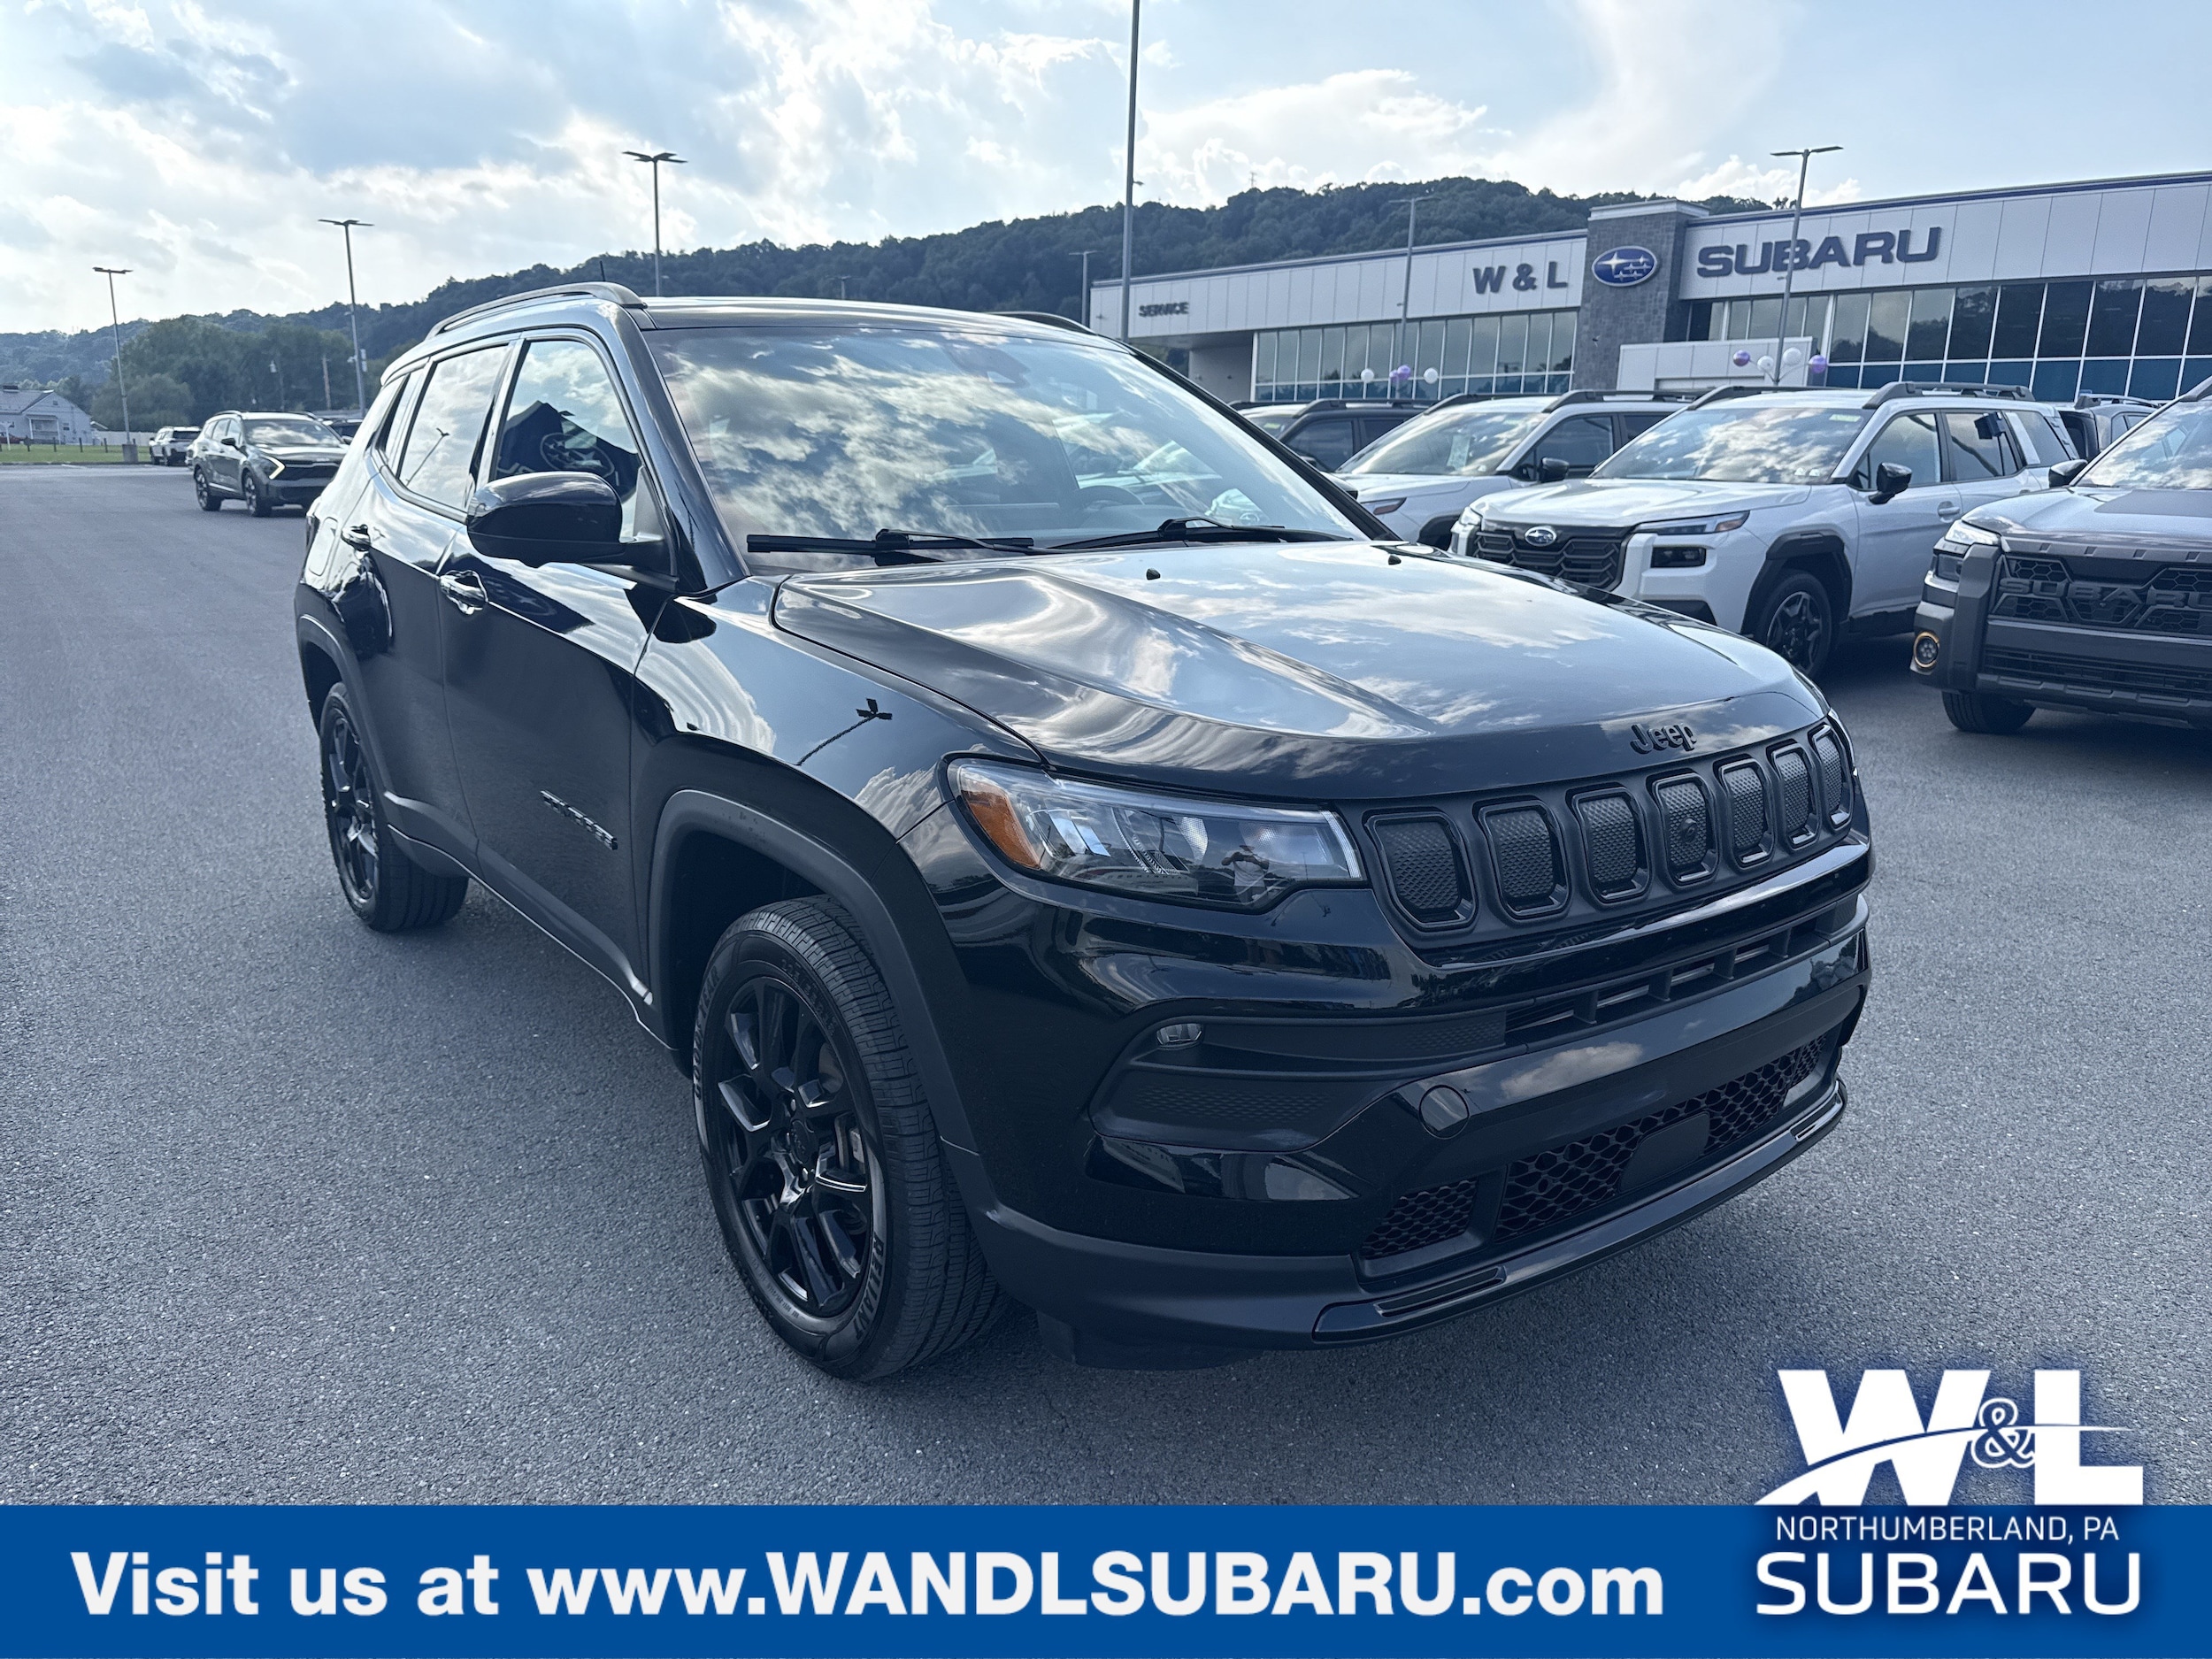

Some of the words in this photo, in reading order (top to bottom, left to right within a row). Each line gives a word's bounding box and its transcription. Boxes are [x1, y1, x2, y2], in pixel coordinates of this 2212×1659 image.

[1697, 227, 1942, 278] SUBARU
[1472, 265, 1507, 295] W
[1512, 263, 1538, 292] &
[1547, 261, 1569, 289] L
[1630, 722, 1698, 755] Jeep
